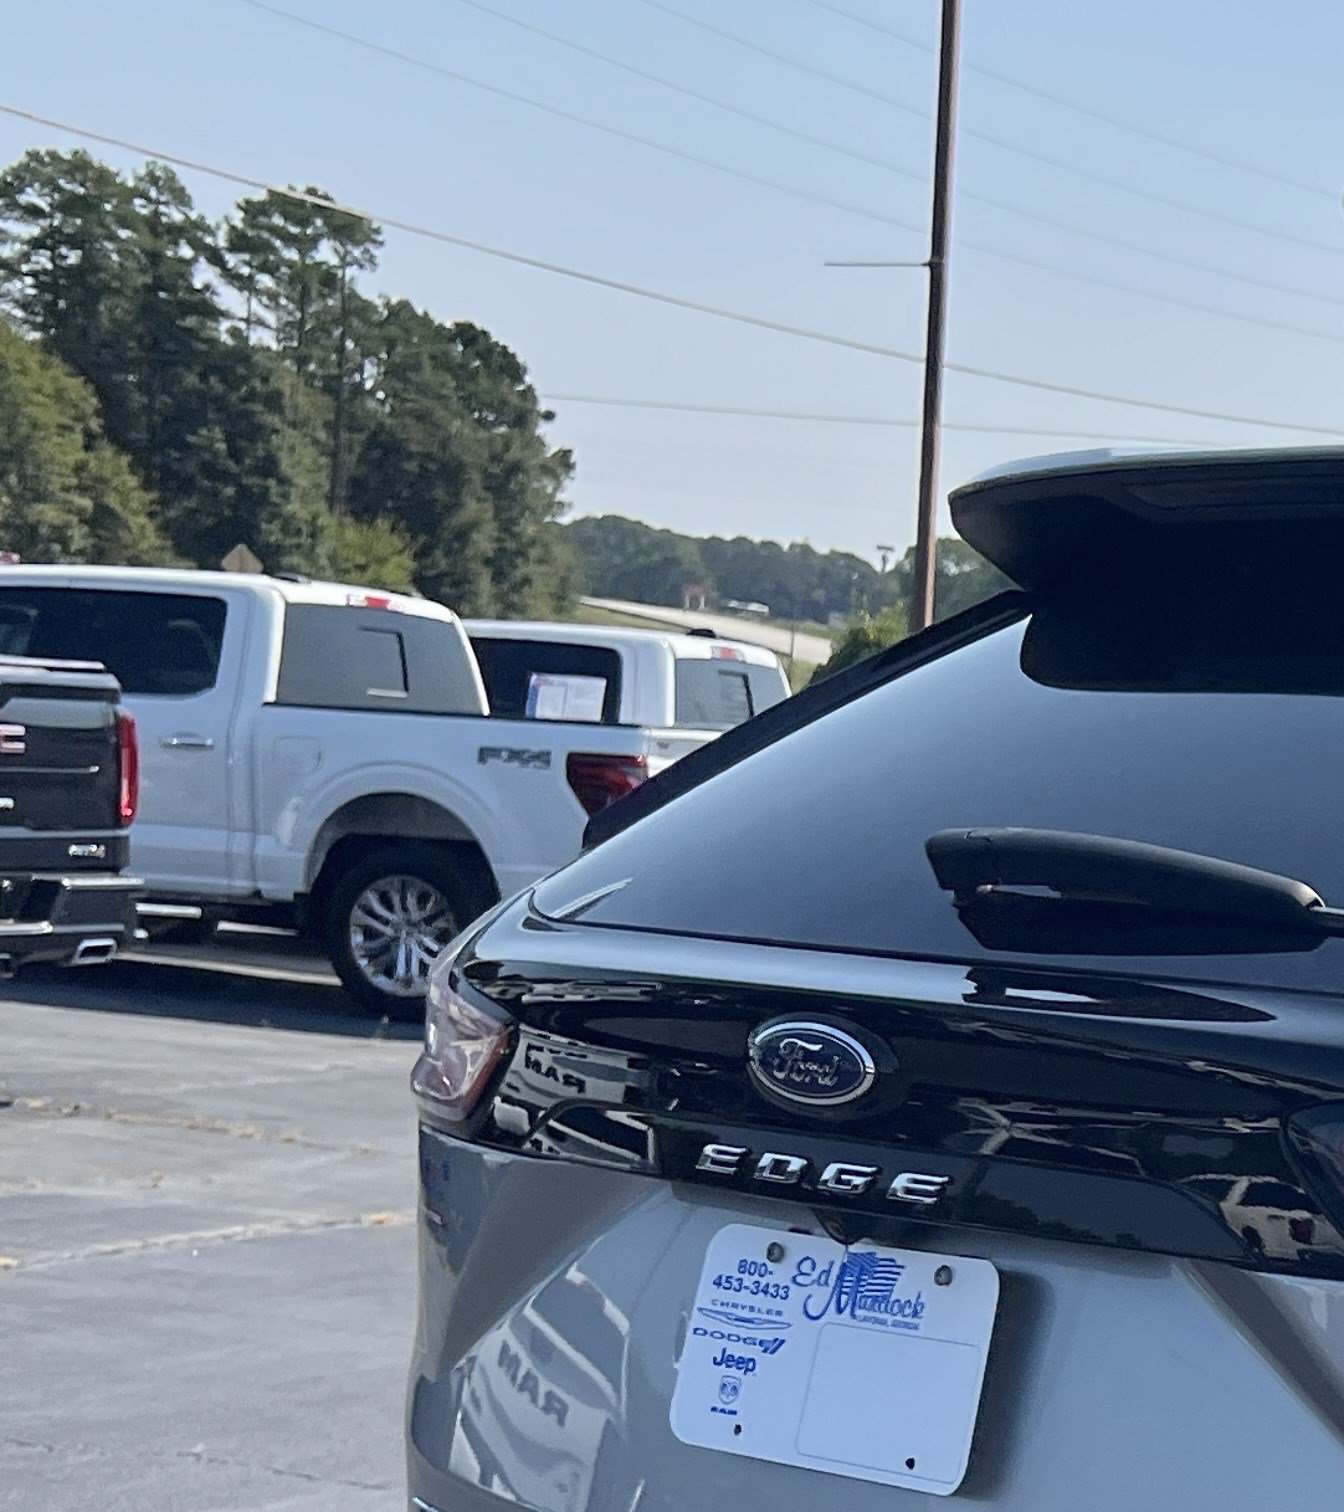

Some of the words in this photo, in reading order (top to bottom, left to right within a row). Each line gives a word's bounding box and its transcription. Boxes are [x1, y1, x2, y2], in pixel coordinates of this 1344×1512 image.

[695, 1143, 951, 1205] EDGE
[791, 1255, 834, 1288] Ed
[712, 1273, 791, 1301] 453-3433
[711, 1298, 785, 1318] CHRYSLER
[692, 1326, 775, 1349] DODGE
[712, 1347, 757, 1376] Jeep
